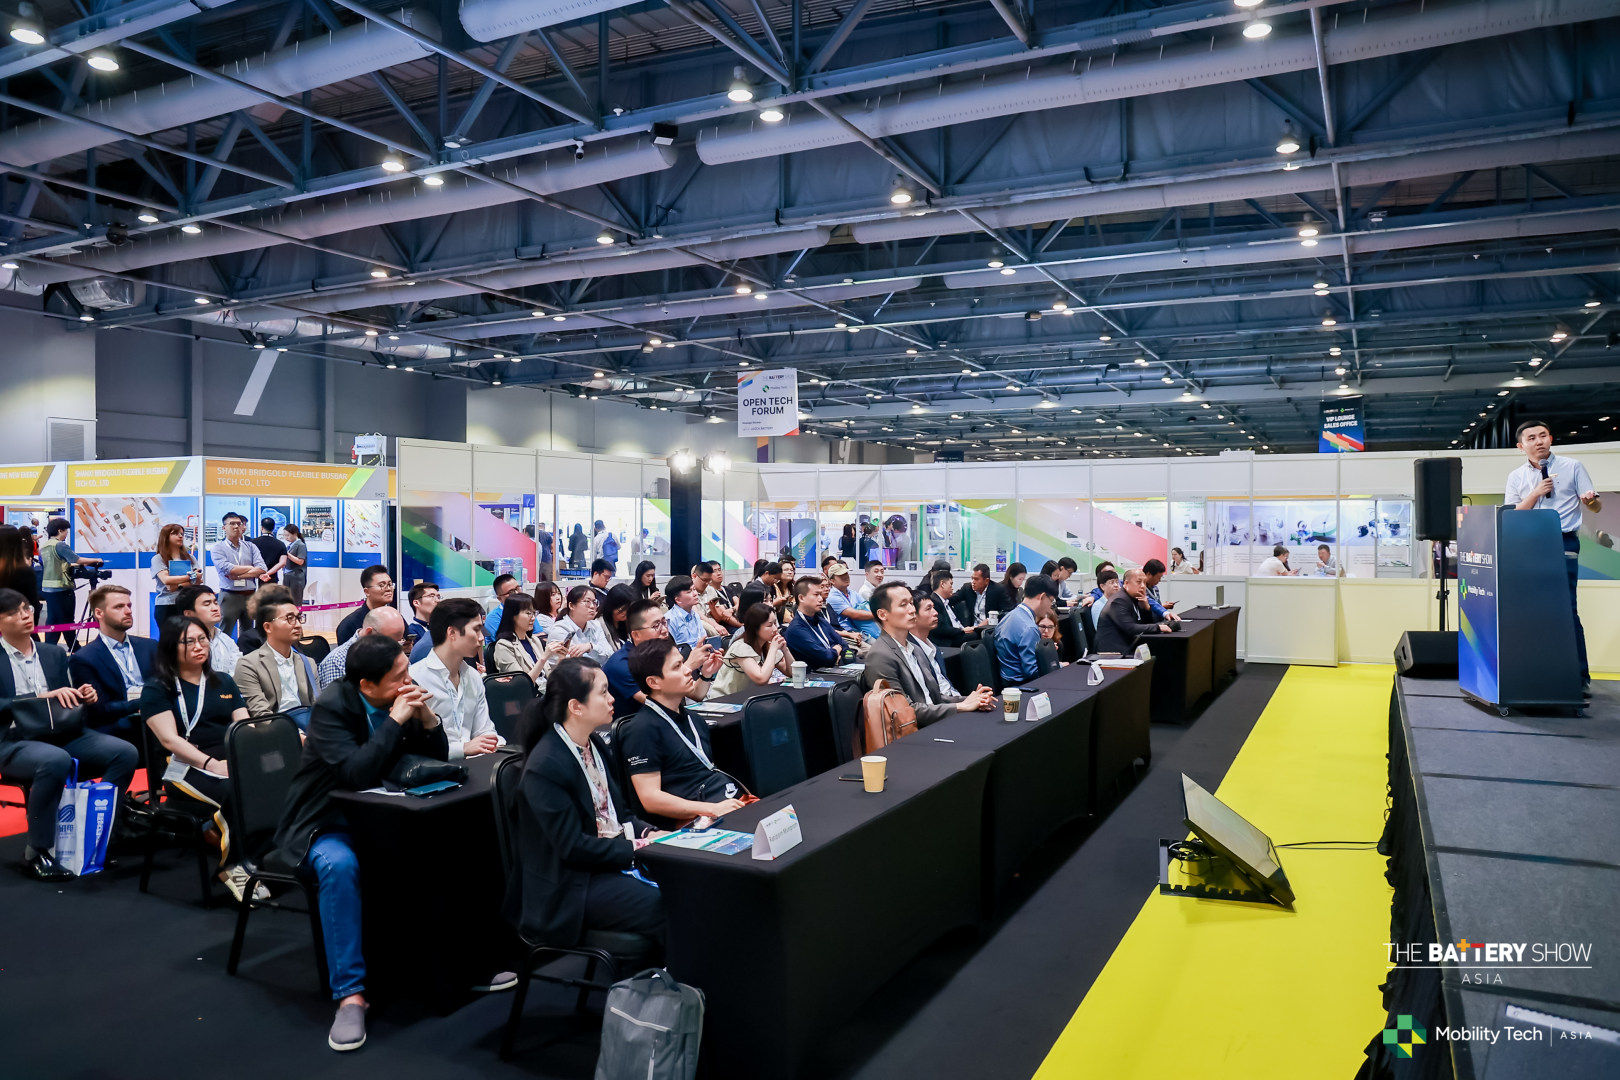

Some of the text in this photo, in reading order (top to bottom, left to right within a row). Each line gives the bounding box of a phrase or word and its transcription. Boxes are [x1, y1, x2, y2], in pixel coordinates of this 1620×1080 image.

[743, 397, 793, 407] OPEN TECH
[752, 406, 784, 416] FORUM
[217, 467, 348, 480] SHANXI BRIDGOLD FLEXIBLE BUSBAR
[217, 478, 238, 486] TECH
[256, 479, 271, 487] LTD
[1466, 551, 1481, 563] BATTERY
[1482, 554, 1492, 564] SHOW
